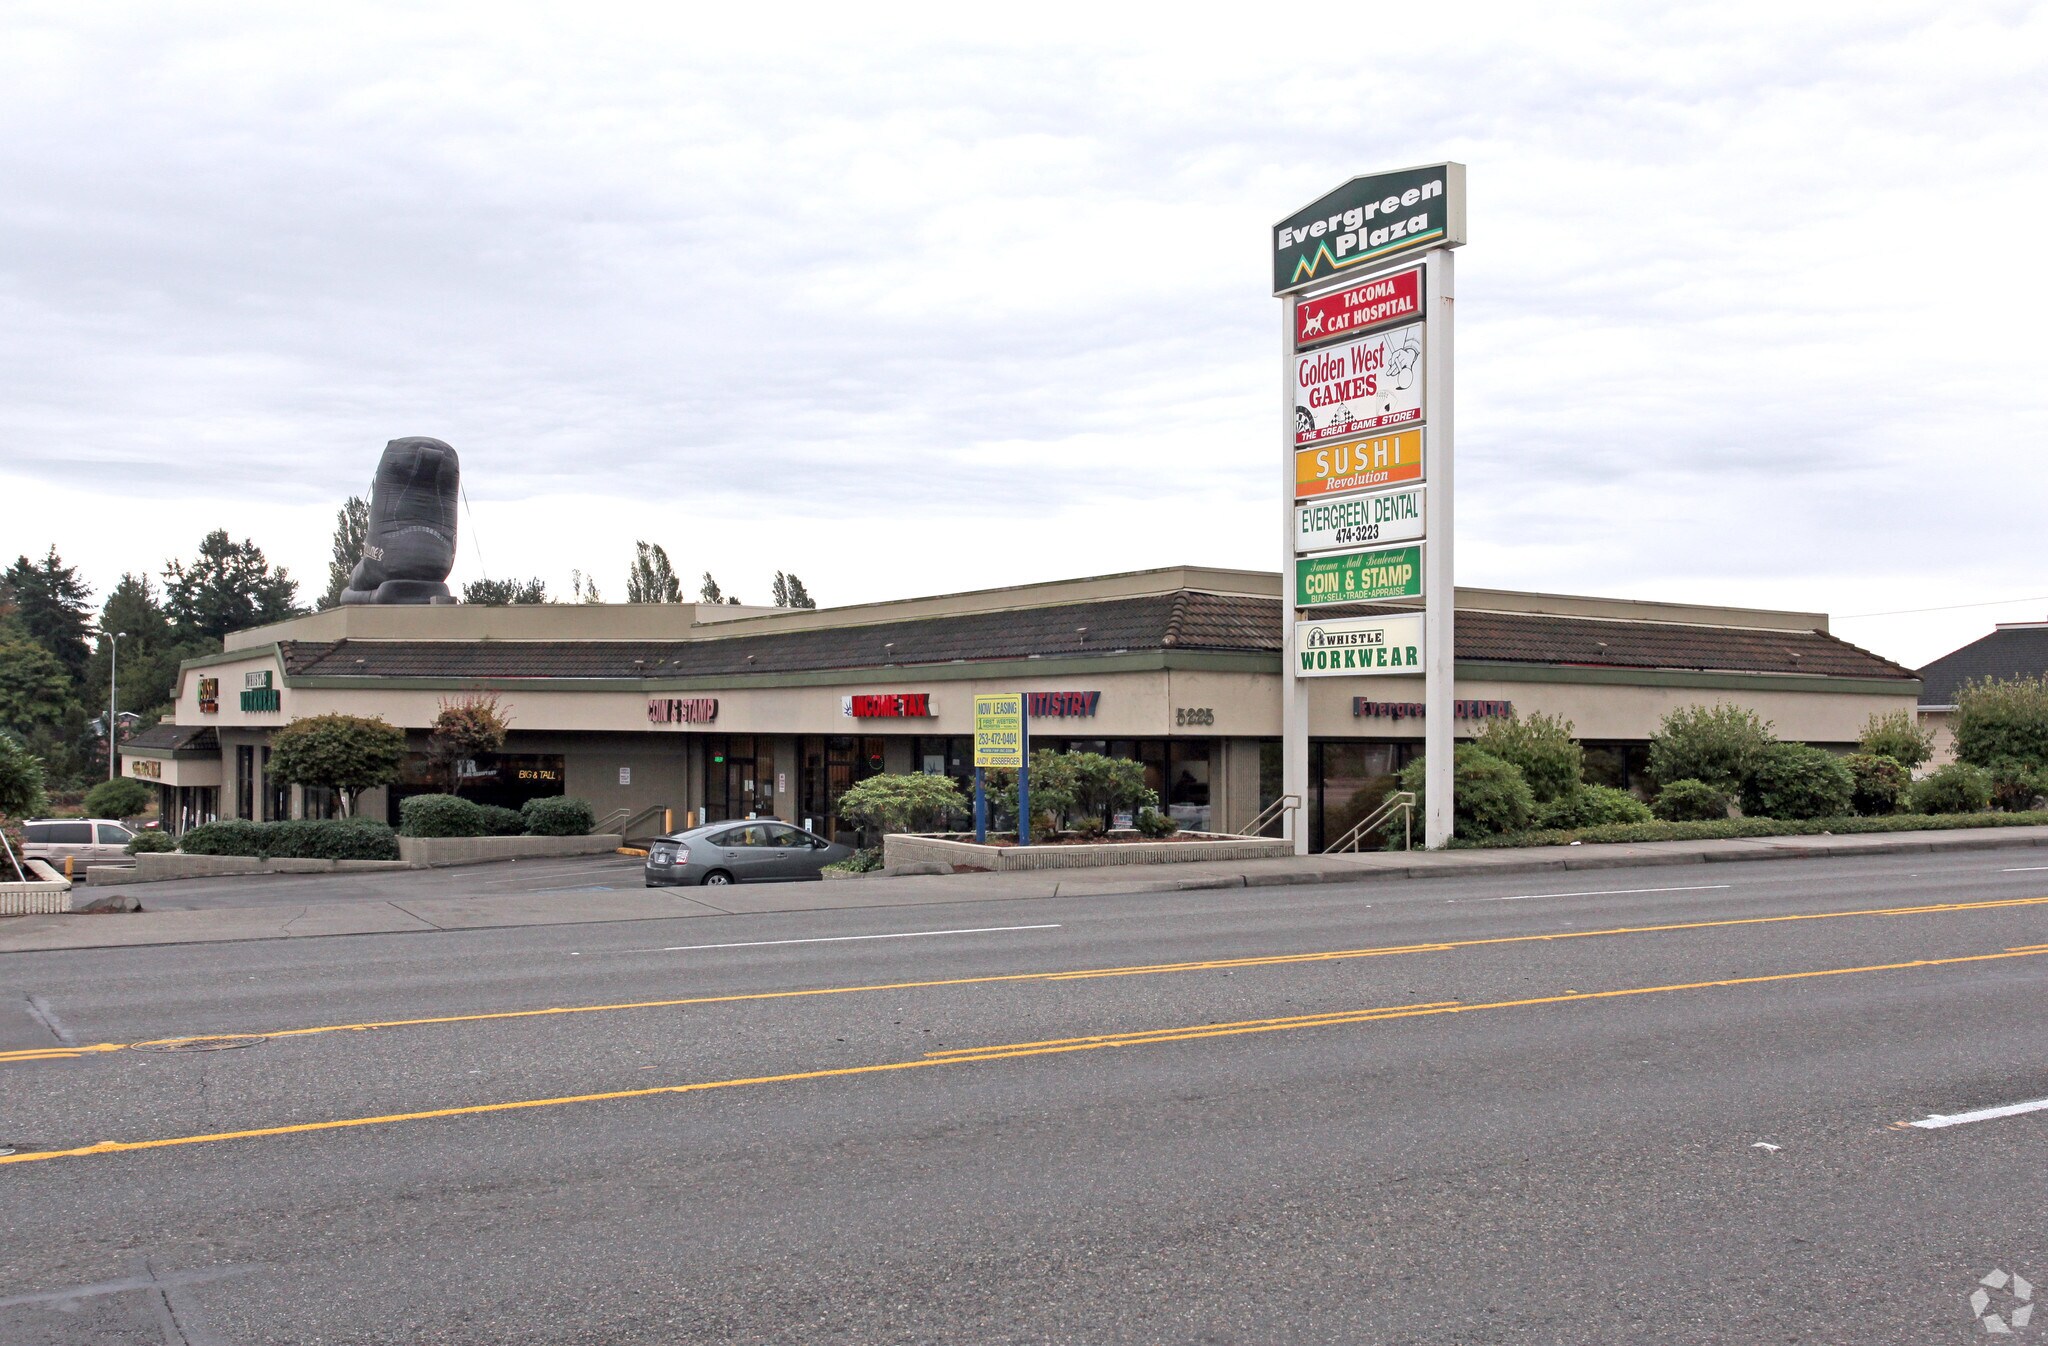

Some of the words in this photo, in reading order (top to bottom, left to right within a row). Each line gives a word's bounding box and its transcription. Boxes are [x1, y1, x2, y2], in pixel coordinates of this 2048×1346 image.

[1278, 179, 1443, 250] Evergreen
[1336, 213, 1428, 257] Plaza
[1344, 281, 1396, 307] TACOMA
[1328, 314, 1350, 331] CAT
[1354, 296, 1413, 325] HOSPITAL
[1299, 352, 1345, 387] Golden
[1351, 341, 1385, 375] West
[1309, 373, 1378, 408] GAMES
[1302, 431, 1317, 441] THE
[1321, 424, 1347, 437] GREAT
[1351, 418, 1378, 431] GAME
[1381, 410, 1415, 425] STORE!
[1316, 437, 1400, 478] SUSHI
[1326, 470, 1388, 490] Revolution
[1302, 501, 1369, 533] EVERGREEN
[1375, 493, 1418, 523] DENTAL
[1336, 524, 1379, 543] 474-3223
[1310, 560, 1338, 572] Tacoma
[1342, 555, 1363, 569] Mall
[1366, 550, 1406, 566] Boulevard
[1306, 573, 1339, 594] COIN
[1345, 570, 1354, 590] &
[1362, 564, 1412, 589] STAMP
[1327, 633, 1382, 645] WHISTLE
[1301, 646, 1418, 670] WORKWEAR
[648, 699, 670, 722] COIN
[681, 699, 717, 723] STAMP
[852, 694, 899, 717] INCOME
[901, 693, 928, 717] TAX
[978, 703, 991, 715] NOW
[993, 702, 1017, 714] LEASING
[1028, 691, 1099, 717] NTISTRY
[1355, 697, 1426, 720] Evergre
[1176, 707, 1214, 726] 5225
[979, 733, 1017, 744] 253-472-0404
[977, 756, 988, 765] ANDY
[518, 770, 532, 779] BIG
[539, 770, 556, 780] TALL
